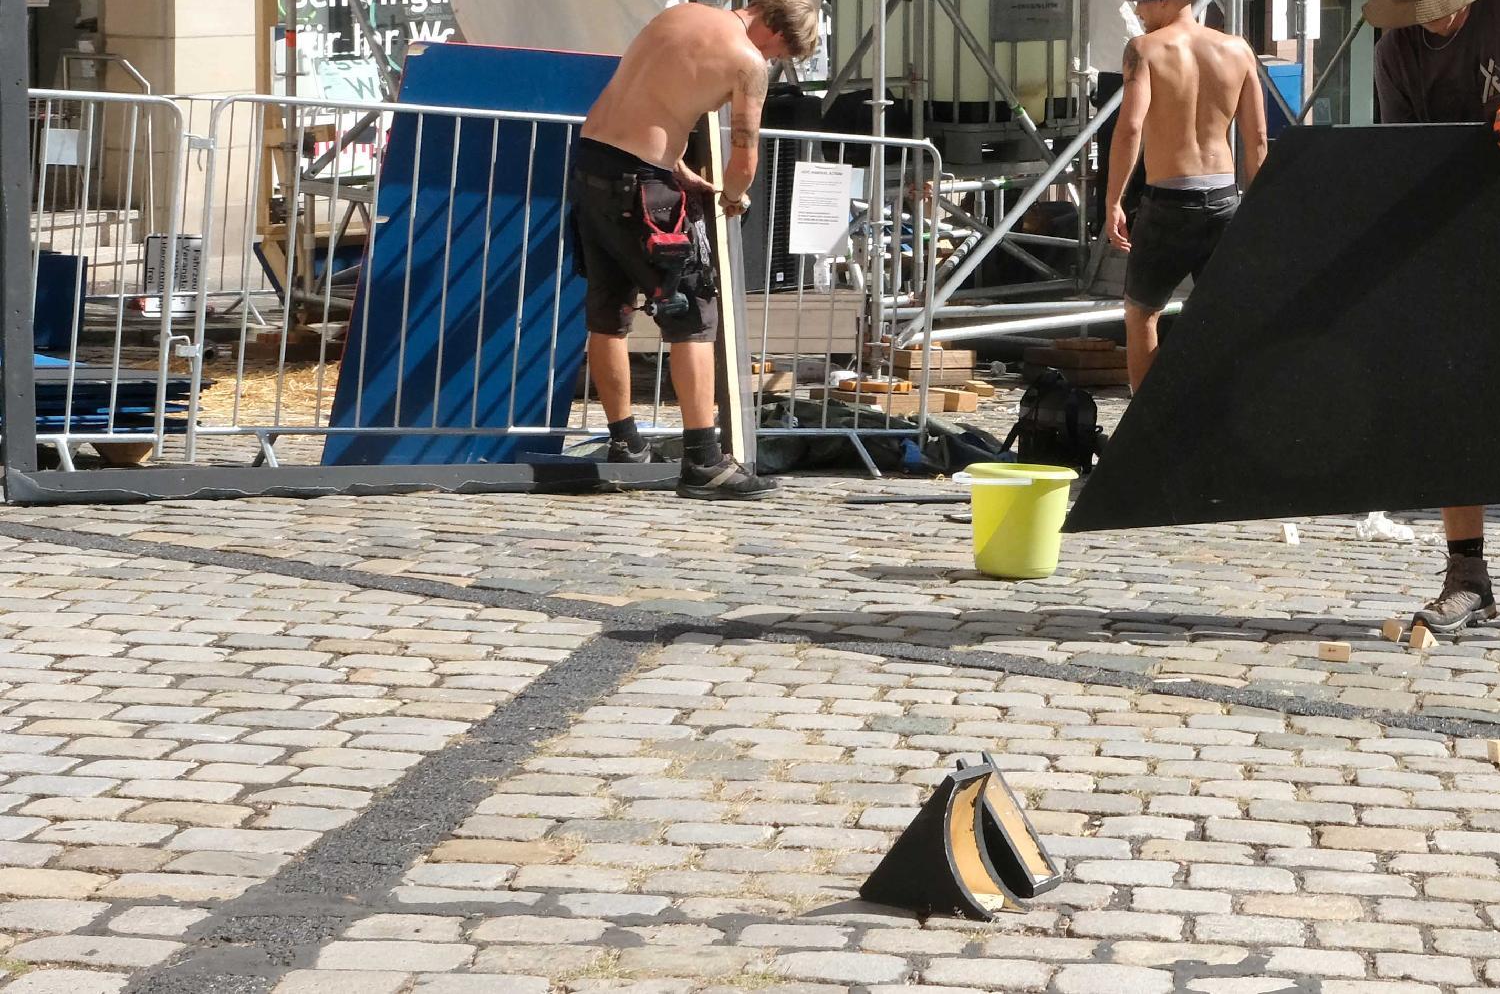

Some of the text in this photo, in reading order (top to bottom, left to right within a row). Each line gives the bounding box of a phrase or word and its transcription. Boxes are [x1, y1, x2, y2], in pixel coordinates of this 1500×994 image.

[147, 266, 155, 284] frei
[180, 245, 190, 307] Veranstaler
[191, 249, 202, 302] Fahrzeue
